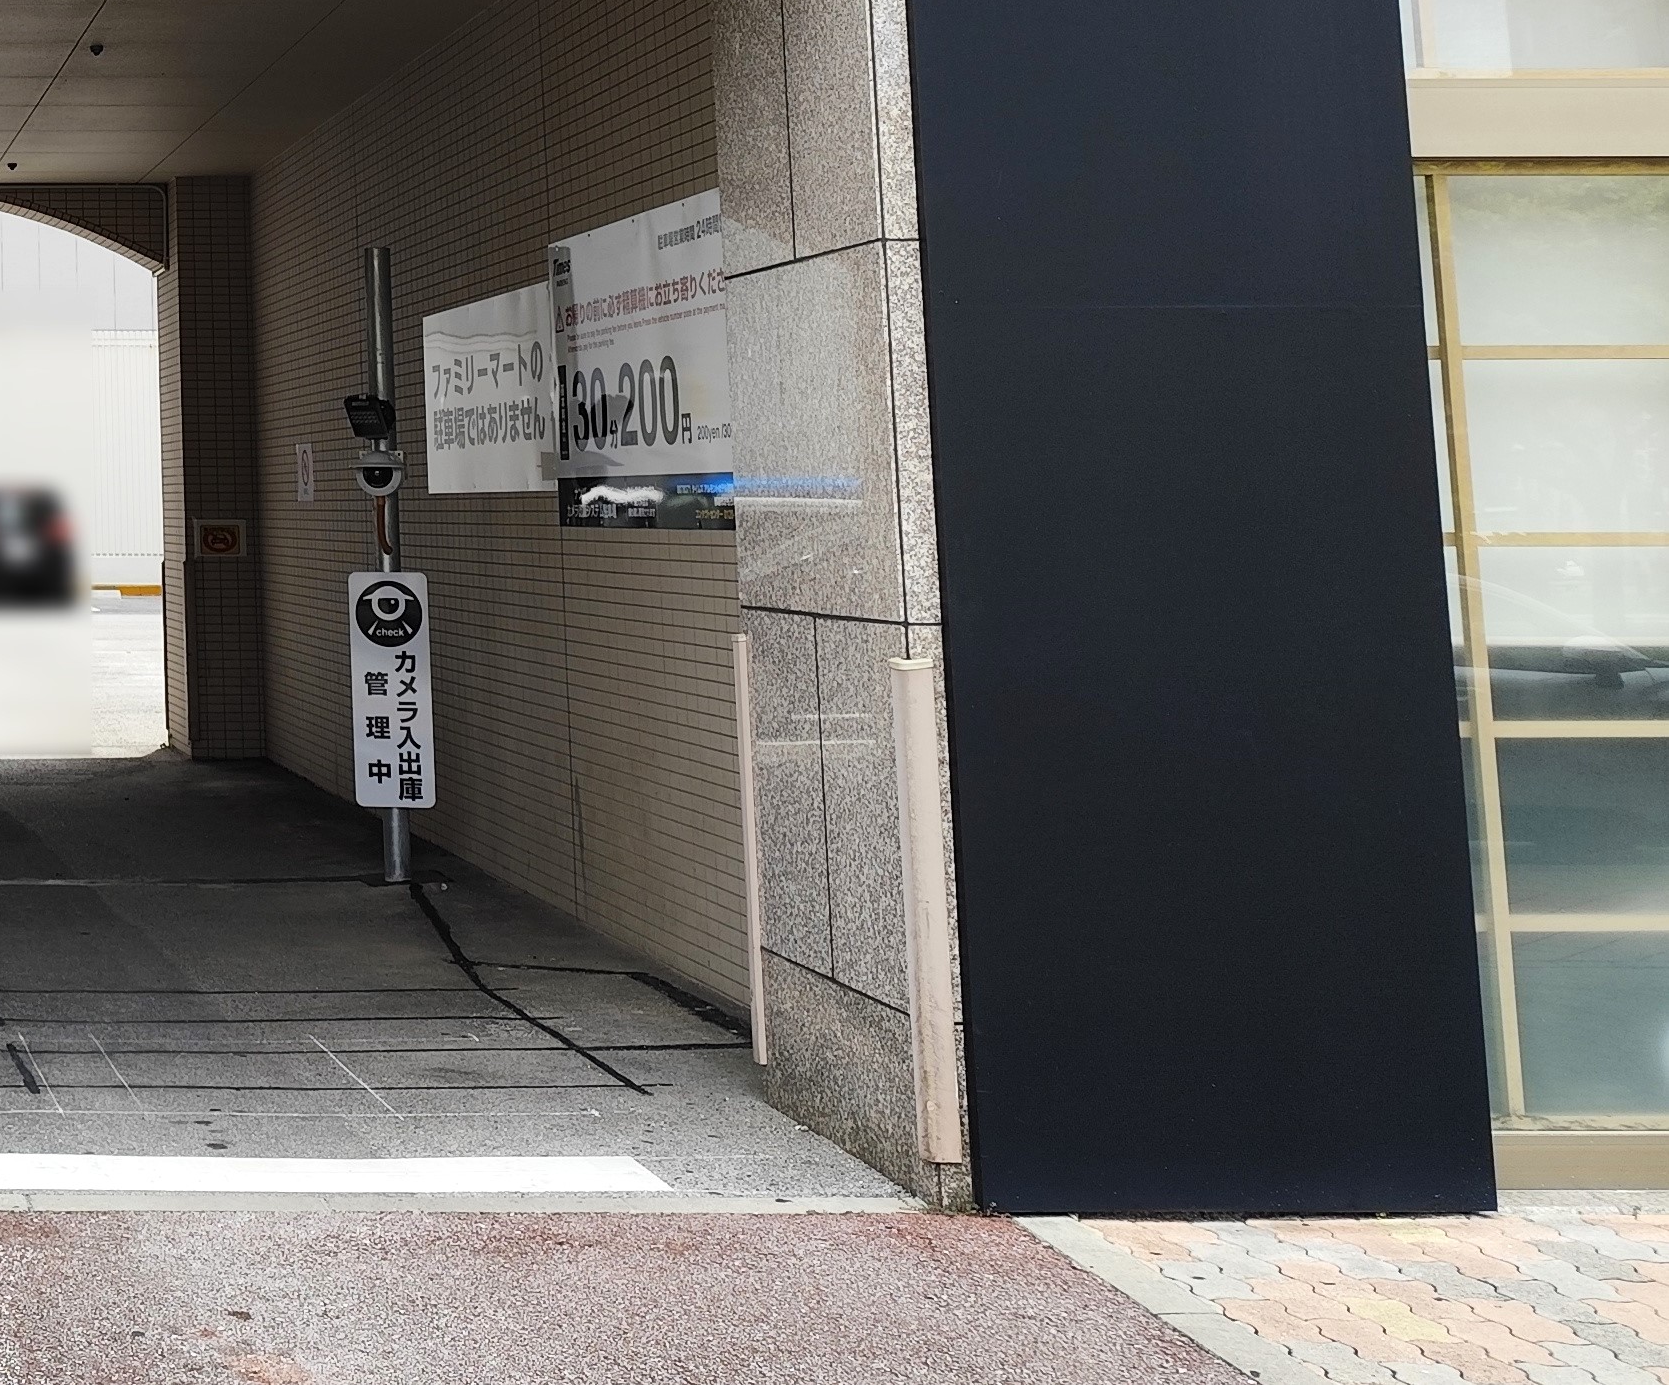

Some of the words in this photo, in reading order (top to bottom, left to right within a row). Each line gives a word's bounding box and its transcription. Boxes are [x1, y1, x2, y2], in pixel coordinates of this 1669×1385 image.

[432, 341, 543, 400] ファミリーマートの
[433, 397, 546, 451] 駐車場ではありません
[376, 627, 404, 637] check
[364, 672, 391, 784] 管理中
[394, 650, 423, 801] カメラ入出庫
